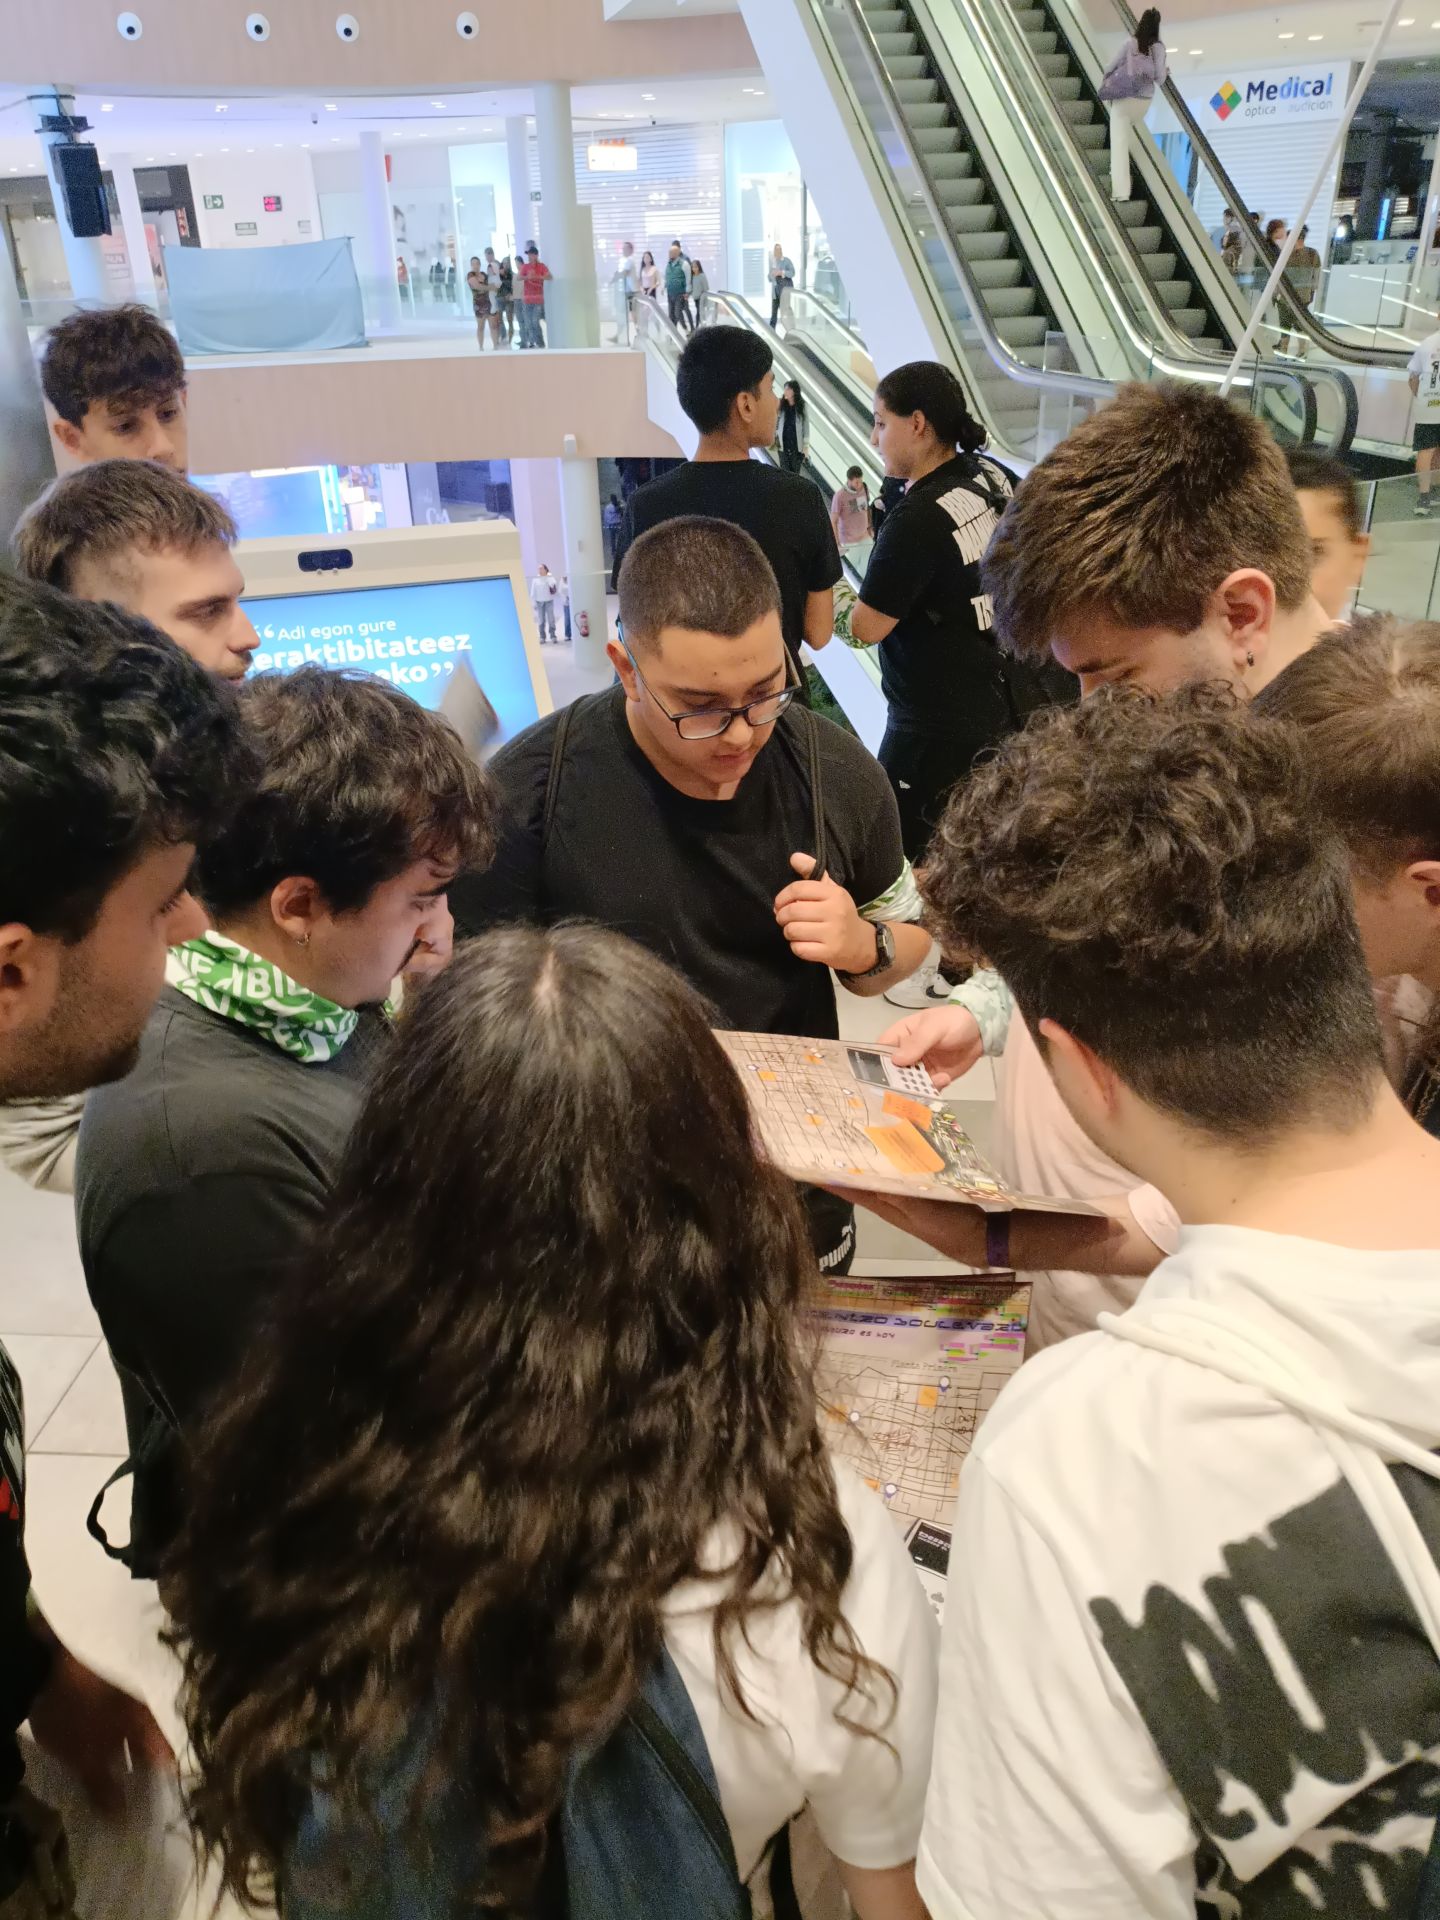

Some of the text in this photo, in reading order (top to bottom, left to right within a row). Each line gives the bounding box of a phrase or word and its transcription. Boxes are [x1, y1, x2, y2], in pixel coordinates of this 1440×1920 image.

[1246, 72, 1333, 103] Medical
[1244, 105, 1276, 118] optica
[310, 624, 354, 640] egon
[358, 619, 397, 637] gure
[246, 633, 473, 672] eraktibitateez
